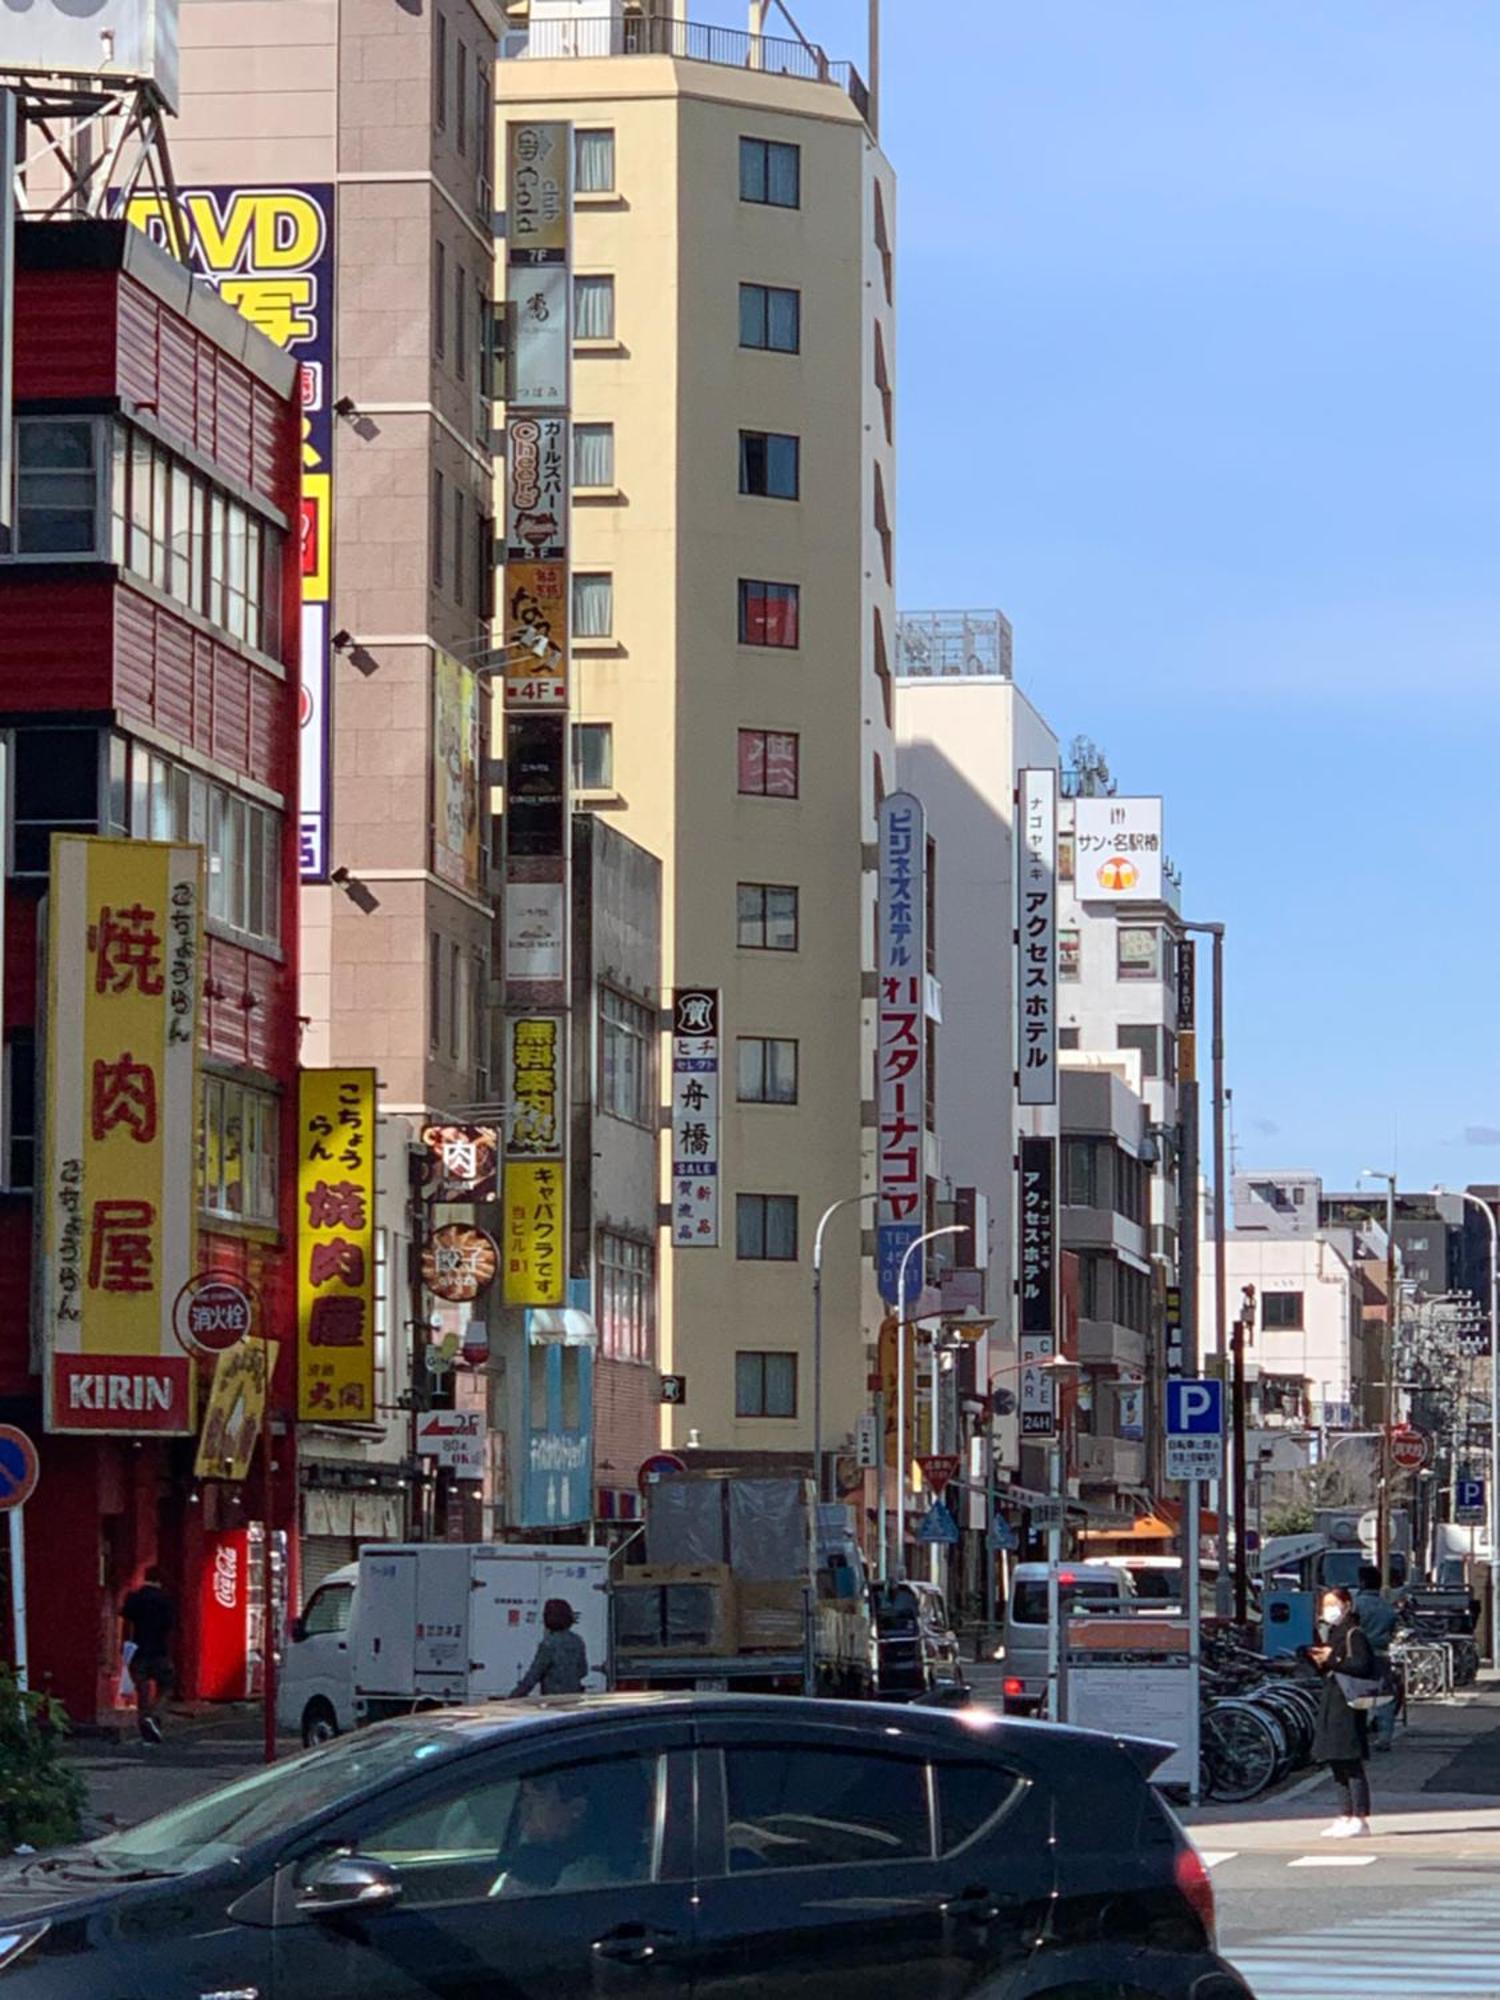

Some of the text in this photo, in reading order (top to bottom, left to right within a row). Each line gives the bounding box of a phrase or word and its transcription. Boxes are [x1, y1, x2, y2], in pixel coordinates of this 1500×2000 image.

[516, 165, 539, 235] Gold
[543, 421, 562, 508] ガールズバー
[520, 682, 551, 700] 4F
[1029, 798, 1044, 881] ナゴヤエキ
[888, 807, 913, 968] ビジネスホテル
[1025, 891, 1049, 1069] アクセスホテル
[86, 902, 165, 1293] 焼肉屋
[680, 1078, 711, 1156] 舟橋
[677, 1163, 712, 1175] SALE
[1023, 1171, 1040, 1300] アクセスホテル
[192, 1304, 246, 1330] 消火栓
[68, 1373, 173, 1412] KIRIN
[1023, 1415, 1050, 1430] 24H
[1179, 1385, 1212, 1430] P
[1464, 1482, 1480, 1504] P
